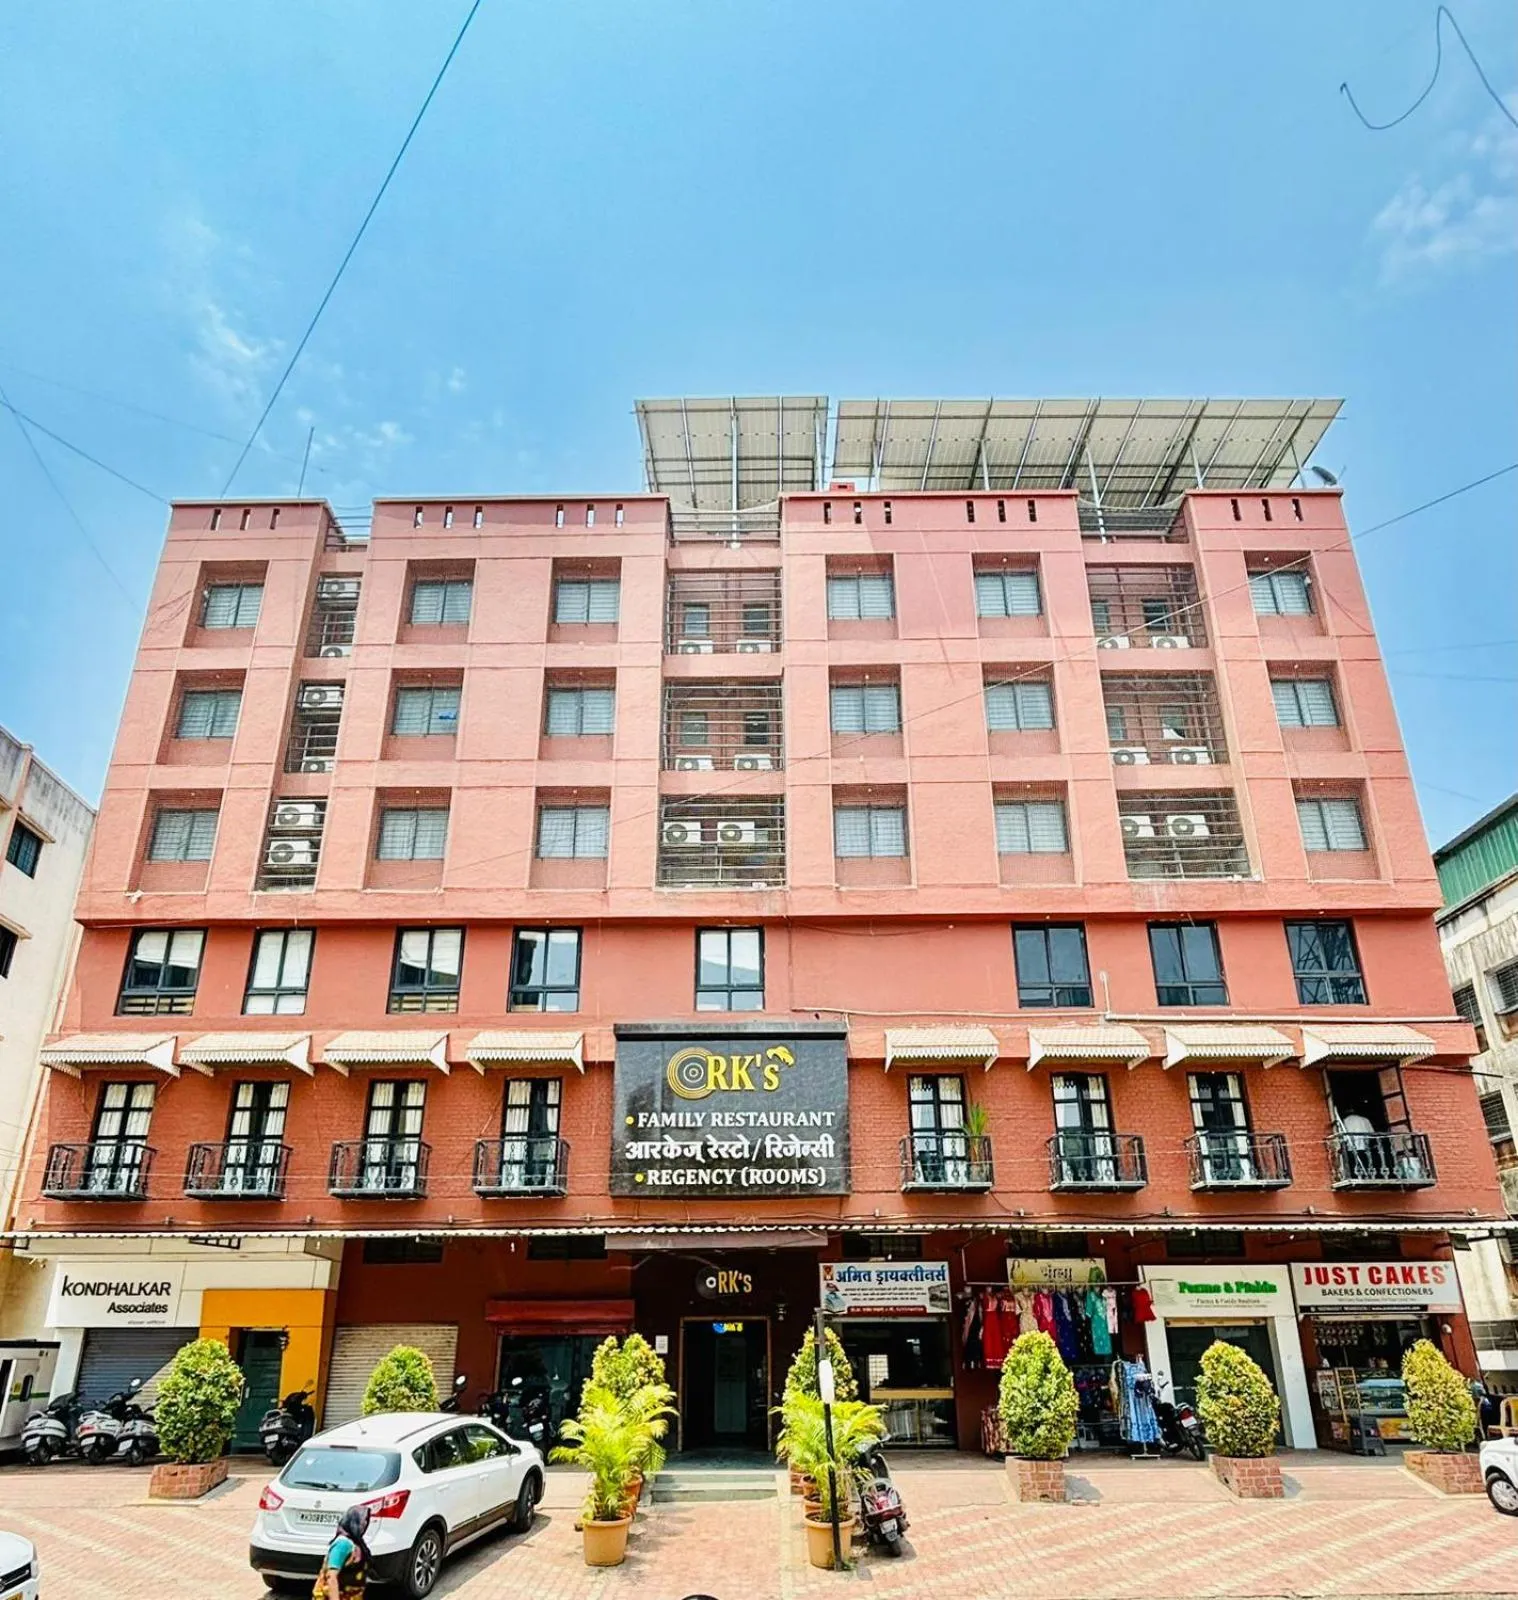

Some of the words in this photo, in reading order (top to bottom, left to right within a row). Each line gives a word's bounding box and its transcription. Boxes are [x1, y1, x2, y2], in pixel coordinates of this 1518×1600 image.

[637, 1112, 706, 1128] FAMILY
[711, 1111, 836, 1127] RESTAURANT
[646, 1169, 736, 1185] REGENCY
[740, 1166, 827, 1187] (ROOMS)
[836, 1265, 872, 1282] अमित
[1304, 1266, 1360, 1285] JUST
[1367, 1265, 1446, 1285] CAKES
[1223, 1281, 1233, 1293] &
[1321, 1287, 1354, 1297] BAKERS
[1356, 1288, 1362, 1296] &
[1364, 1287, 1434, 1296] CONFECTIONERS
[107, 1301, 168, 1314] Associates
